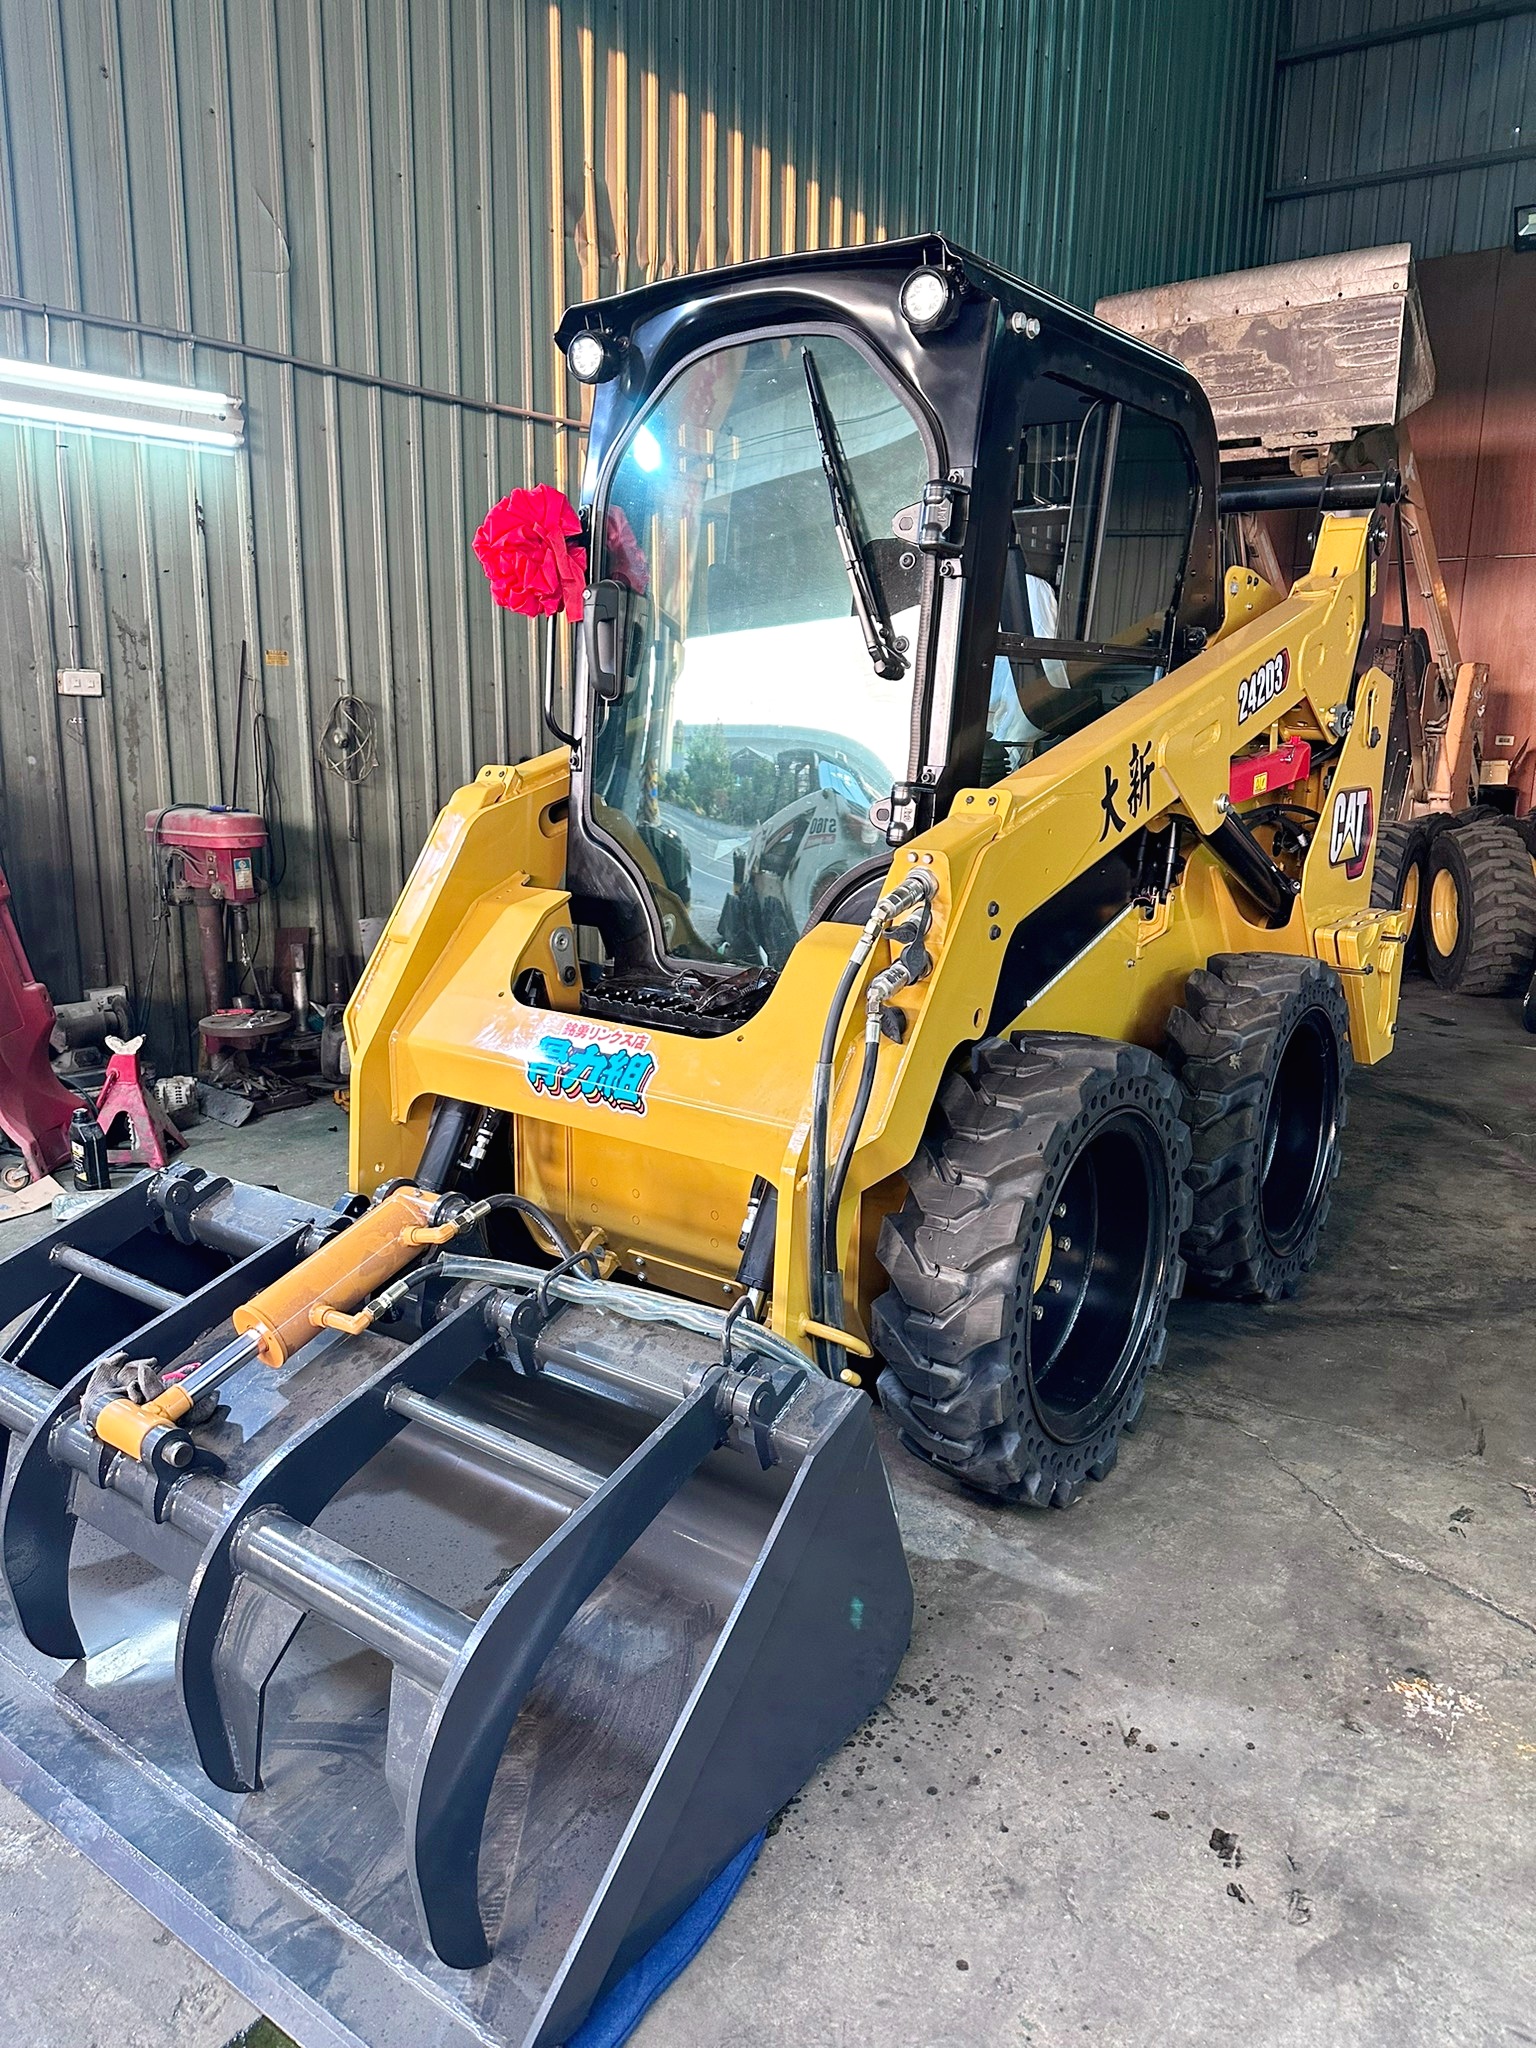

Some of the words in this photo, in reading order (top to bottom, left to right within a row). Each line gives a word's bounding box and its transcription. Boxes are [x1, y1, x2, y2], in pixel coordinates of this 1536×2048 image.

[1238, 652, 1285, 724] 242D3
[1099, 741, 1155, 842] 大新
[1330, 790, 1369, 864] CAT
